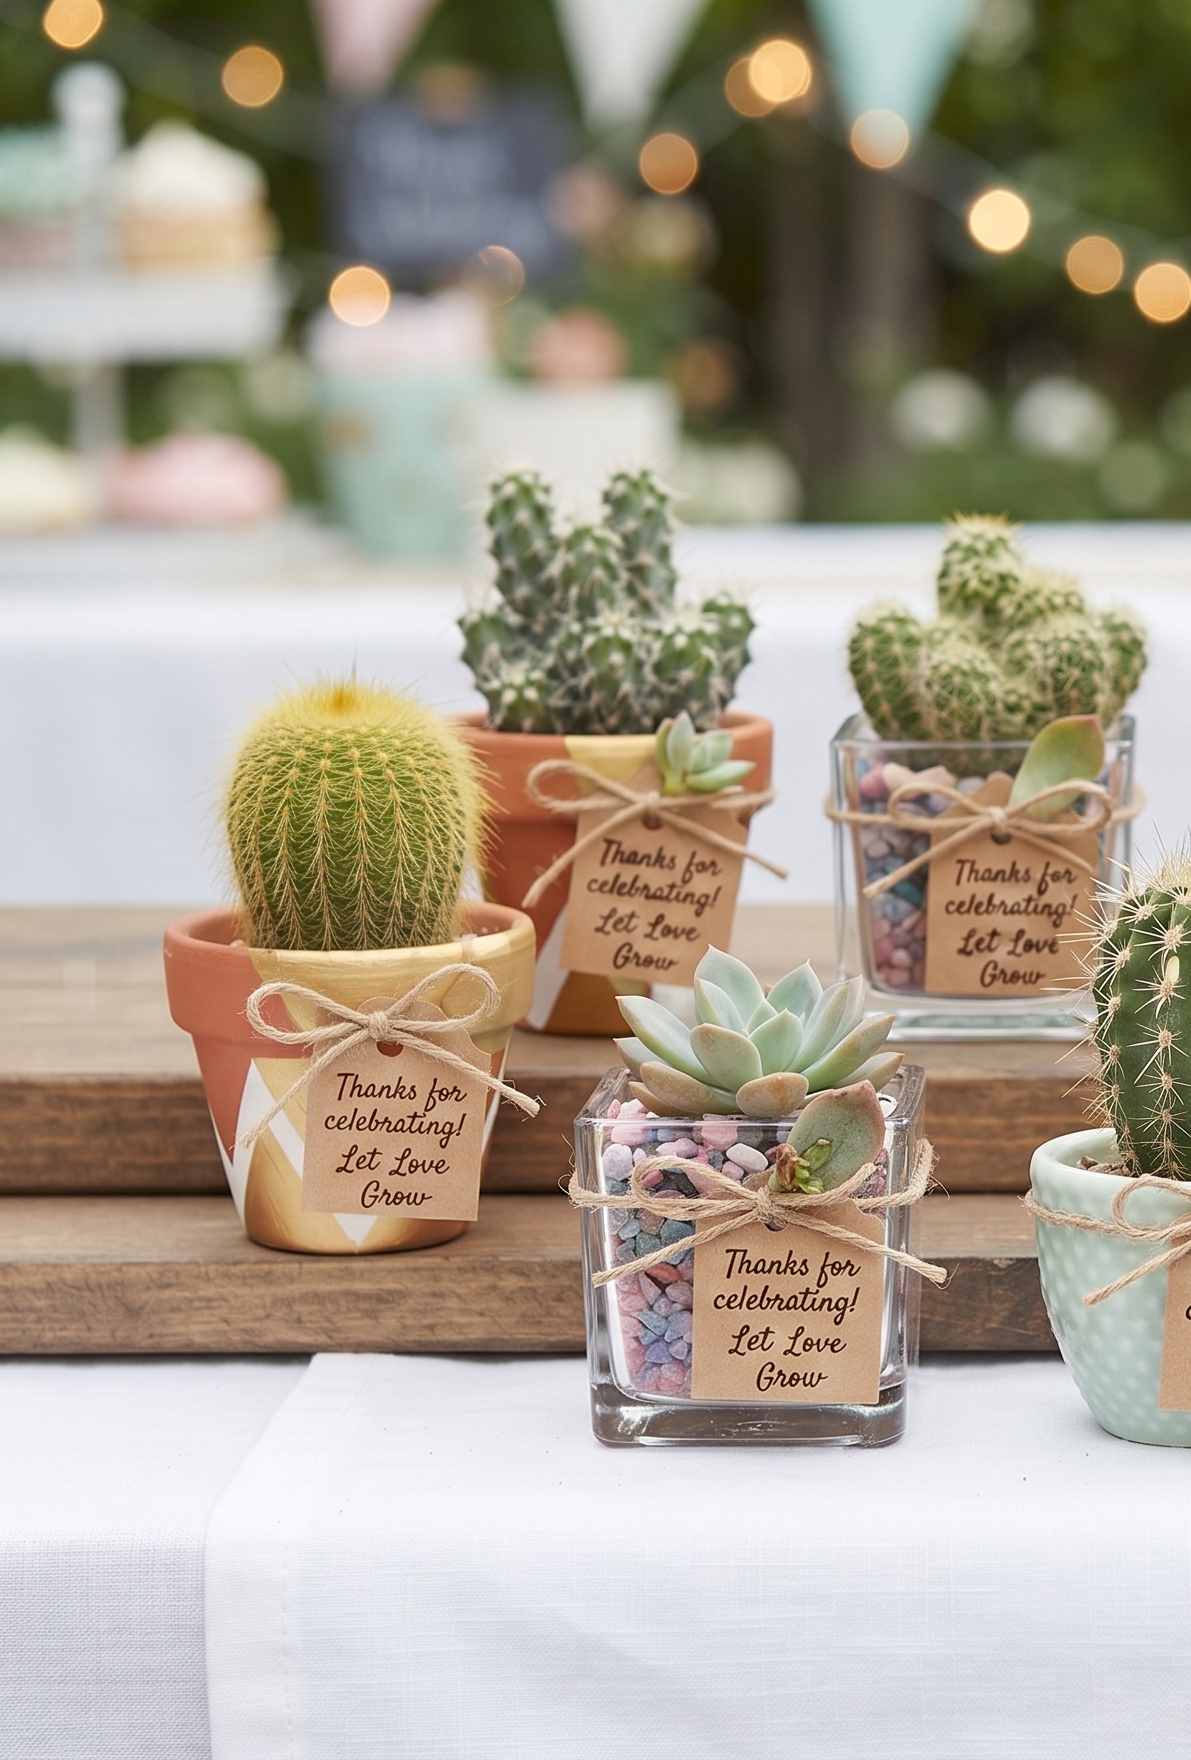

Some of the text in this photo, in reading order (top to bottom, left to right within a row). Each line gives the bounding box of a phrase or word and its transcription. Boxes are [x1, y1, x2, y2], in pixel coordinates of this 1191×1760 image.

[600, 838, 723, 884] Thanks for
[956, 859, 1077, 895] Thanks for
[587, 872, 722, 917] celebrating!
[945, 892, 1078, 928] celebrating!
[594, 907, 701, 941] Let Love
[613, 942, 678, 970] Grow
[957, 928, 1059, 957] Let Love
[980, 960, 1046, 988] Grow
[337, 1073, 468, 1112] Thanks for
[325, 1108, 467, 1149] celebrating!
[335, 1144, 450, 1176] Let Love
[361, 1180, 433, 1208] Grow
[725, 1249, 861, 1288] Thanks for
[713, 1285, 860, 1325] celebrating!
[728, 1325, 847, 1356] Let Love
[756, 1362, 828, 1391] Grow
